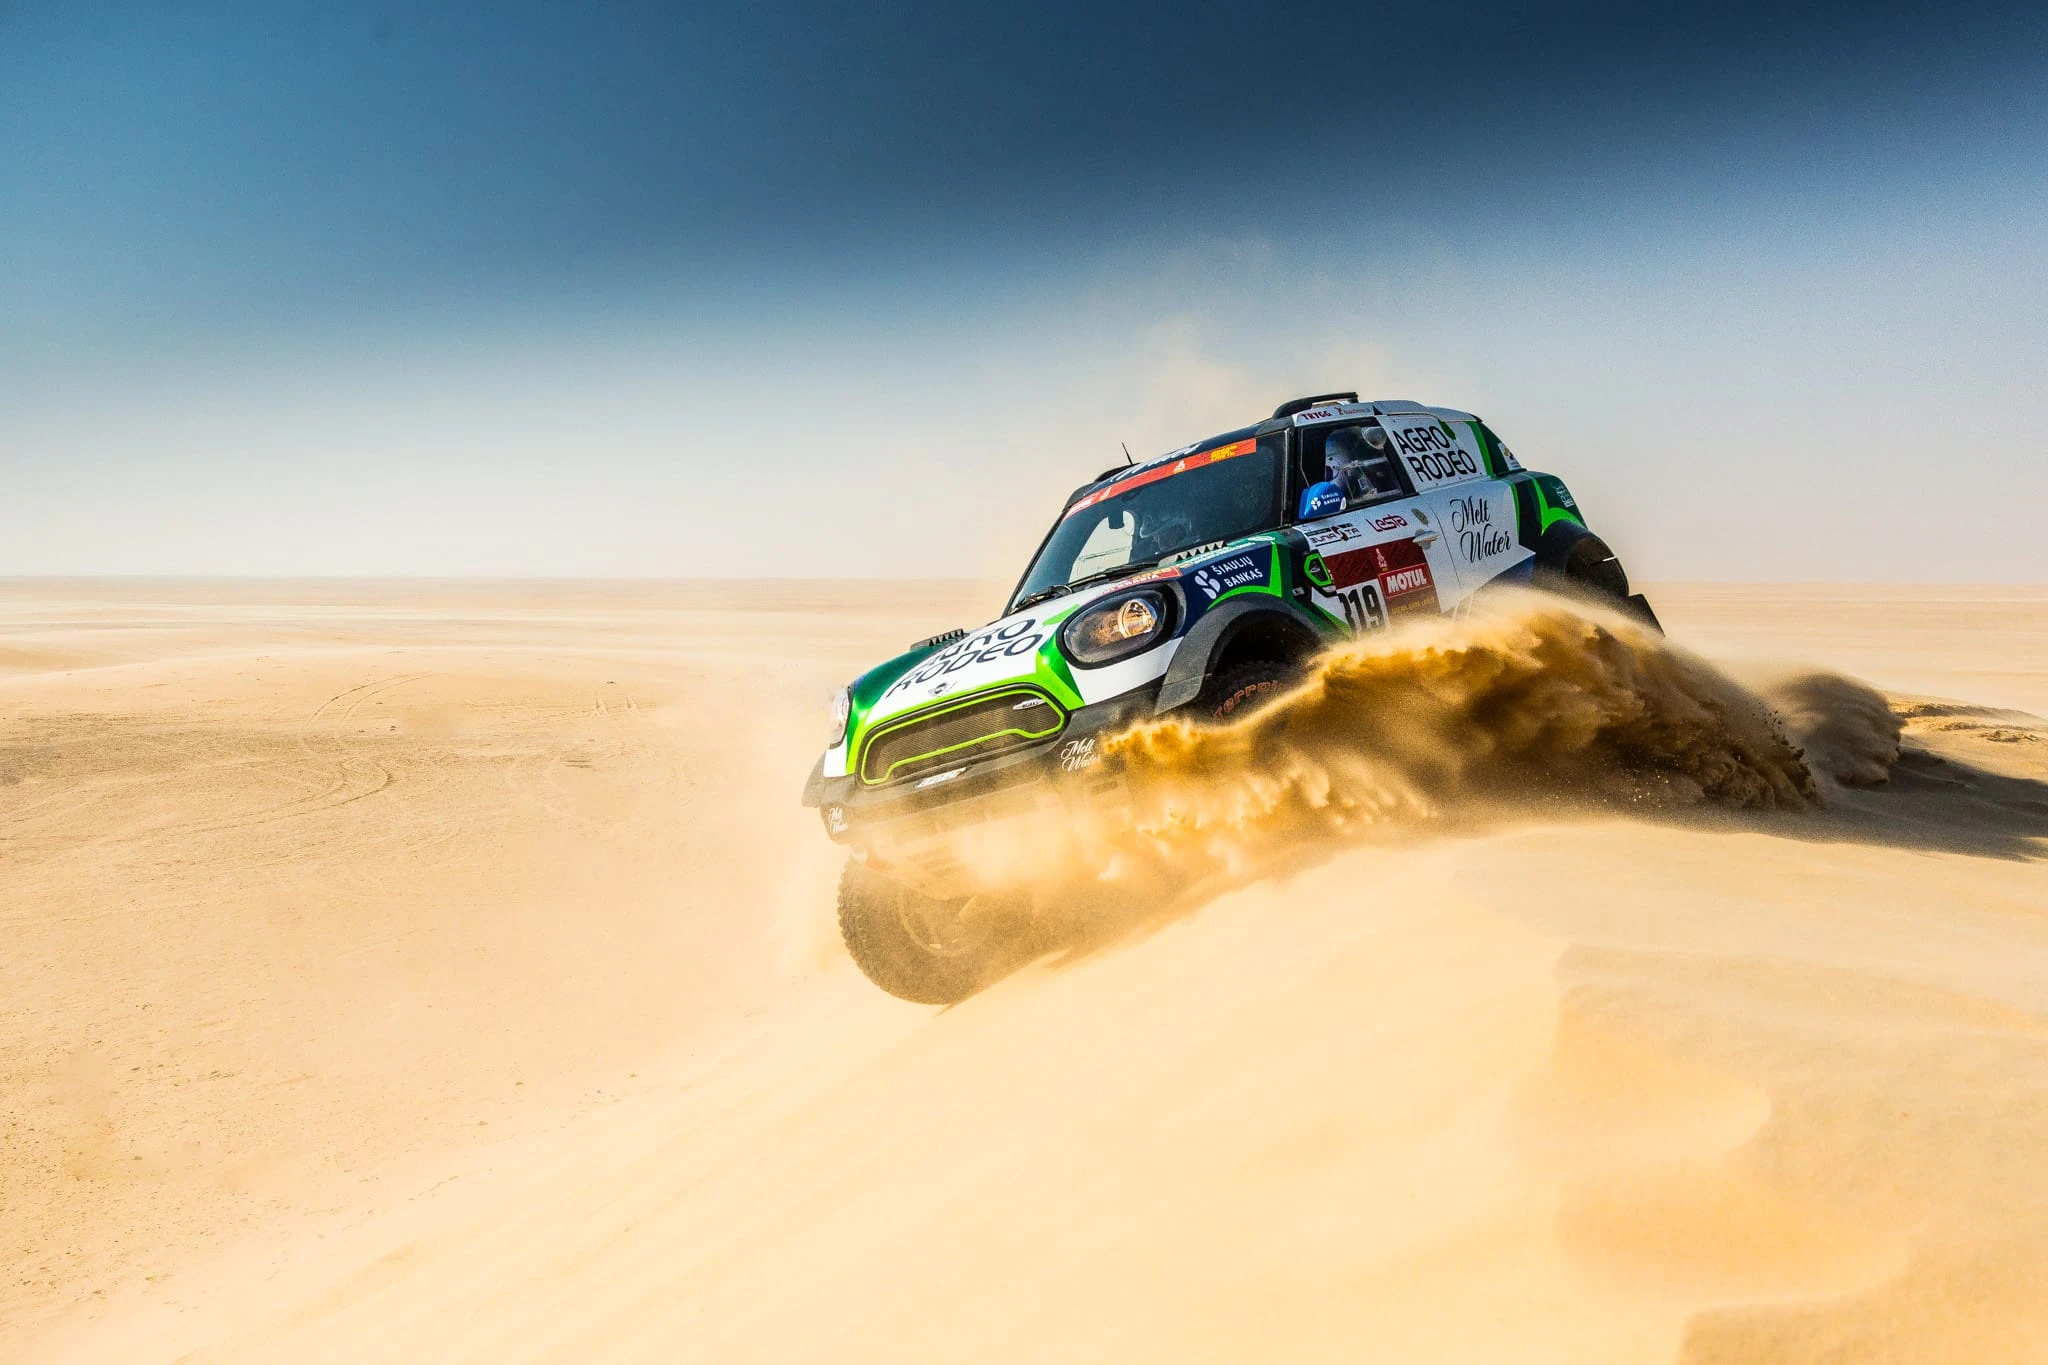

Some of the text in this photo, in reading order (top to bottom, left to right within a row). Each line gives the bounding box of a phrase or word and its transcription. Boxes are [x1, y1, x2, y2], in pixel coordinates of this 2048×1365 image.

[1393, 425, 1451, 455] AGRO
[1407, 449, 1478, 482] RODEO
[1450, 495, 1491, 533] Melt
[1460, 524, 1512, 563] Water
[1210, 556, 1253, 576] ŠIAULIŲ
[1223, 568, 1263, 588] BANKAS
[1386, 568, 1427, 594] MOTUL
